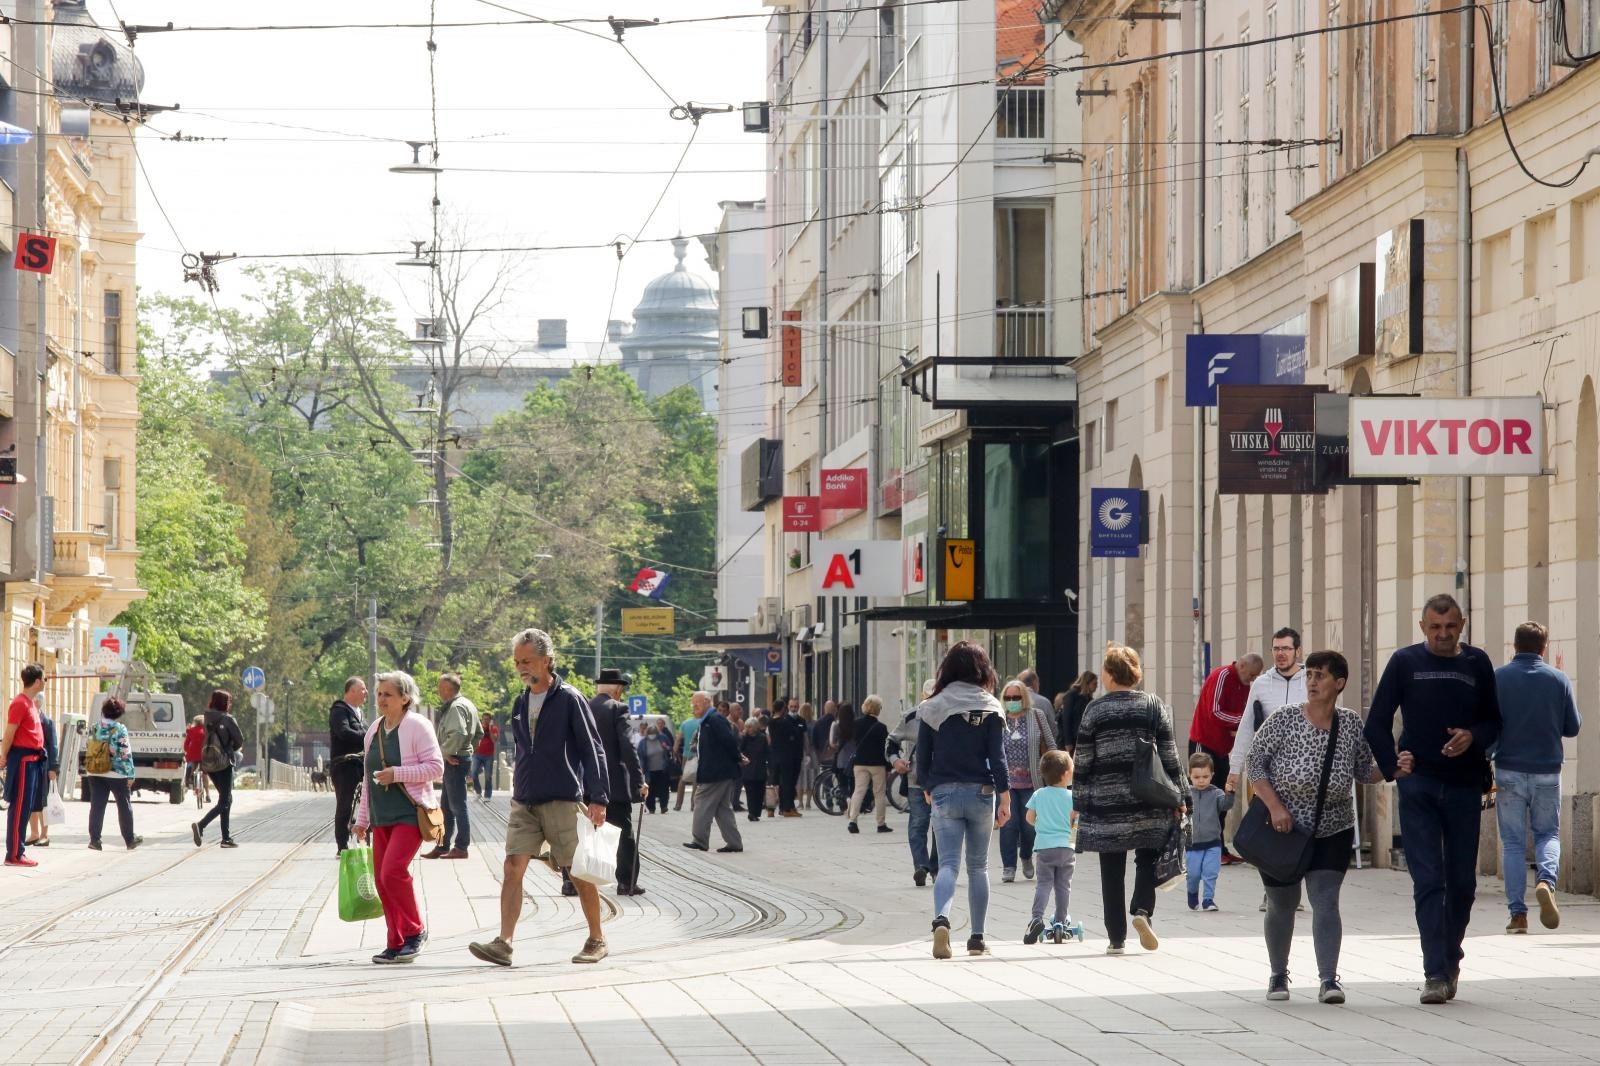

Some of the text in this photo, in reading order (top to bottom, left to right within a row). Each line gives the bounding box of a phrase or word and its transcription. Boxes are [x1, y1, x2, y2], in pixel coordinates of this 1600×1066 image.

[22, 239, 49, 268] S
[1230, 434, 1269, 449] VINSKA
[1360, 419, 1533, 455] VIKTOR
[822, 549, 861, 588] A1
[633, 699, 643, 712] P
